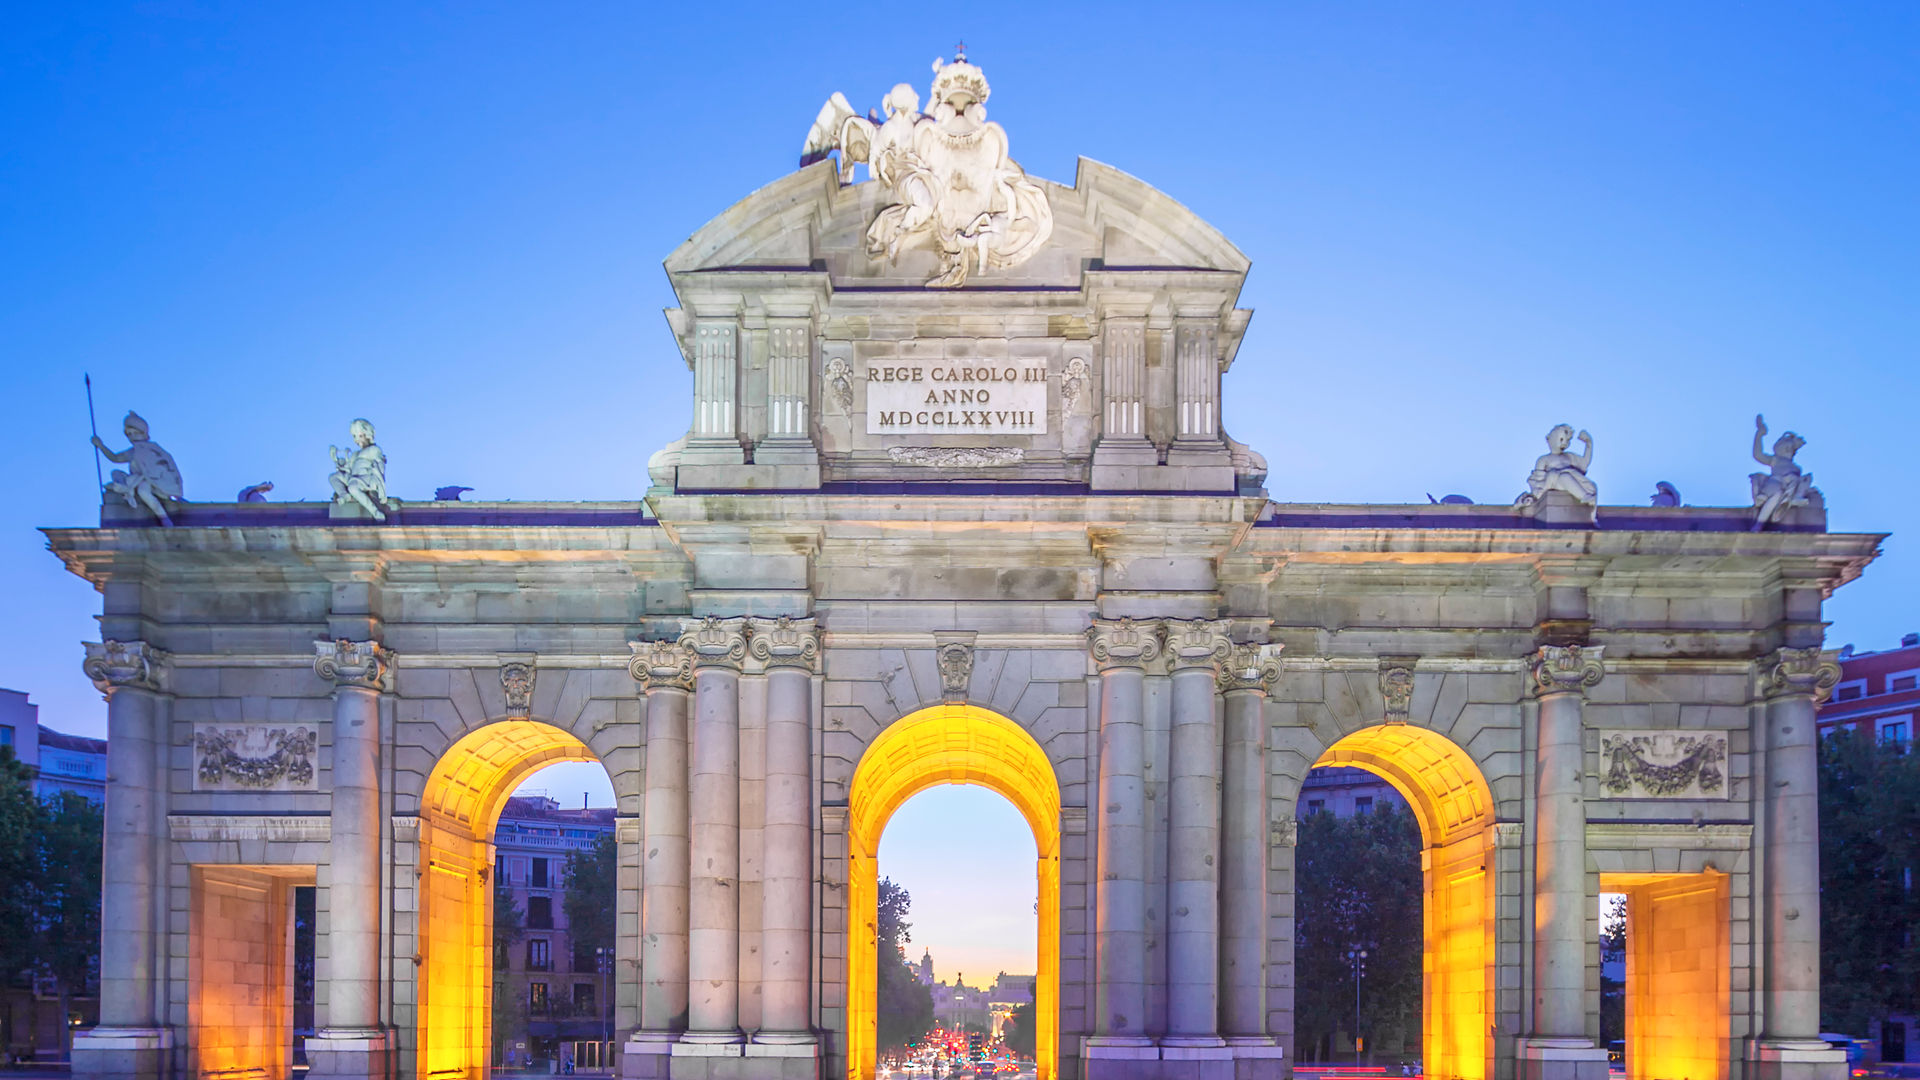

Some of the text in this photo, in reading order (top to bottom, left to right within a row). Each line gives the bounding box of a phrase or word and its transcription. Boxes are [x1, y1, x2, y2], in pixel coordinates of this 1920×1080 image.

[868, 367, 1047, 382] REGE CAROLO III
[925, 389, 990, 403] ANNO
[879, 411, 1035, 425] MDCCLXXVIII
